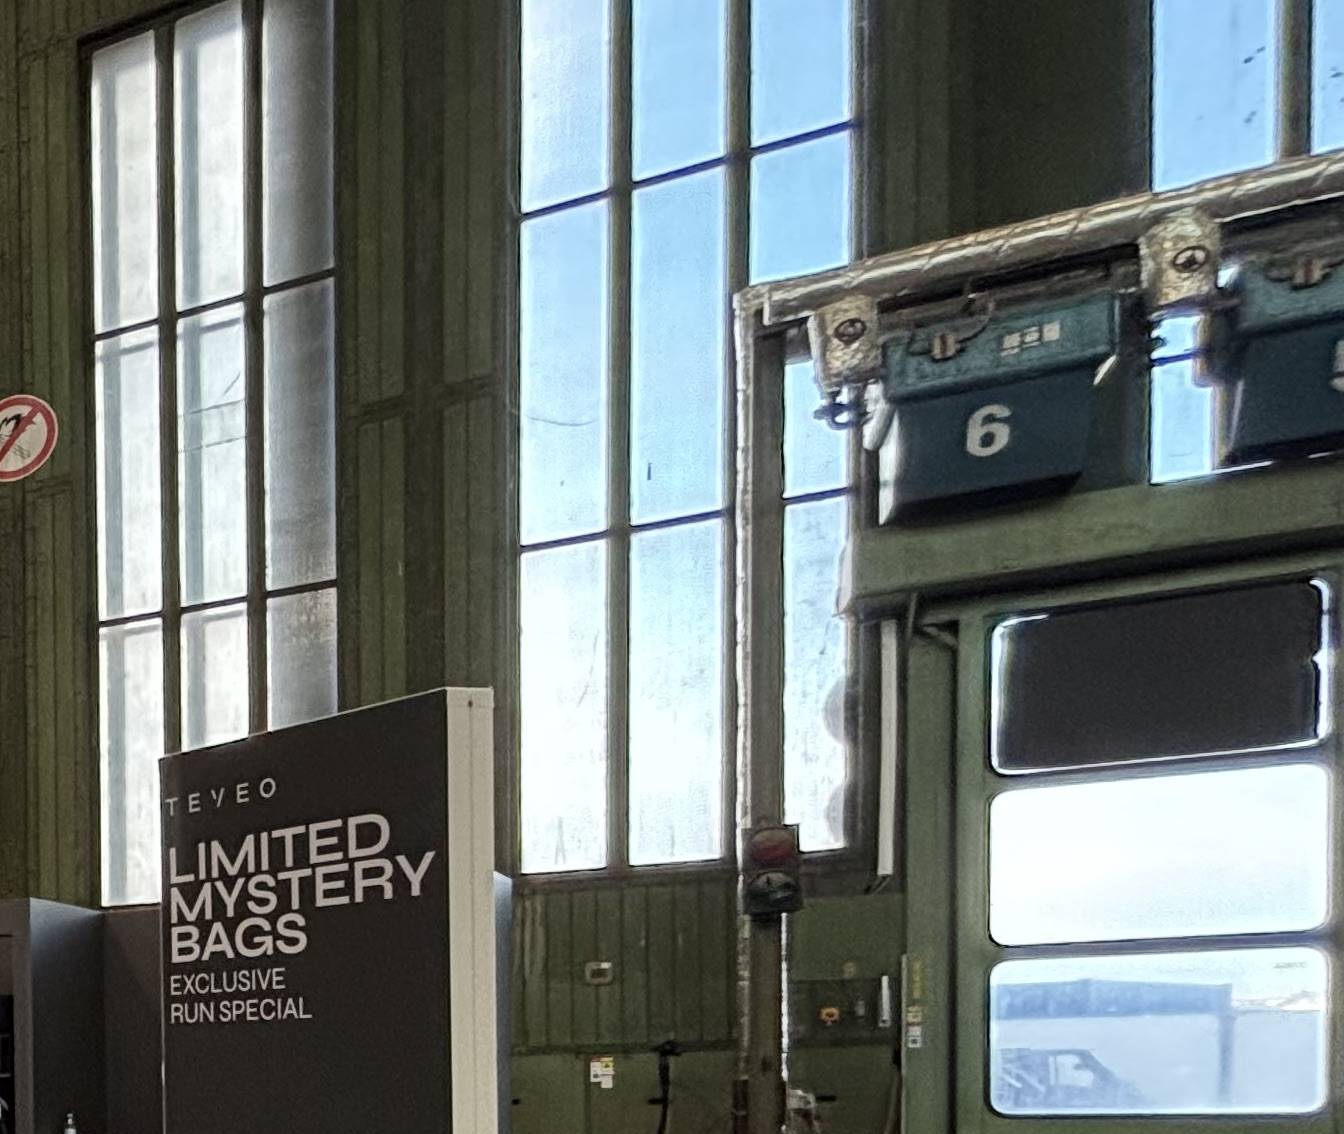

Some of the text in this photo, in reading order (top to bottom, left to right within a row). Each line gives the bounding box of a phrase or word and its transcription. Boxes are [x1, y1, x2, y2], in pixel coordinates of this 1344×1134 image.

[965, 404, 1012, 458] 6
[165, 778, 277, 816] TEVEO
[169, 813, 391, 884] LIMITED
[170, 851, 436, 924] MYSTERY
[170, 913, 308, 964] BAGS
[170, 968, 286, 996] EXCLUSIVE
[170, 997, 312, 1024] RUN SPECIAL
